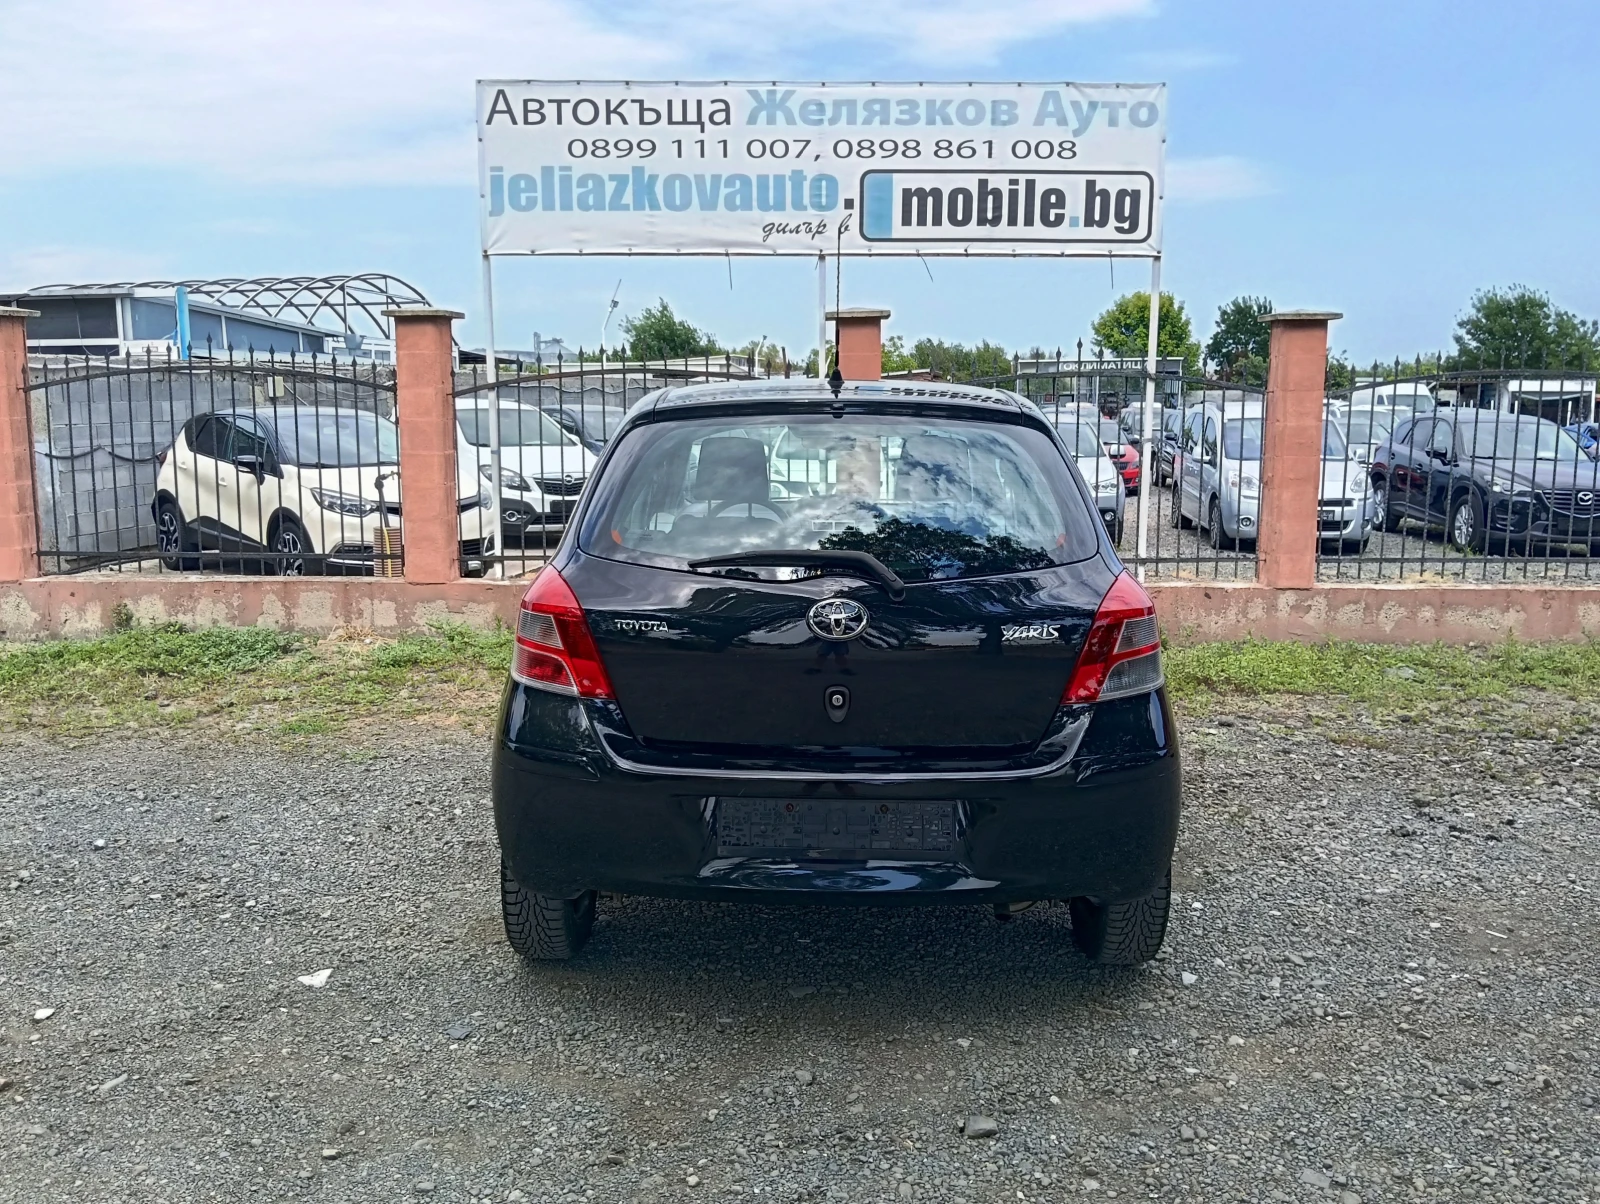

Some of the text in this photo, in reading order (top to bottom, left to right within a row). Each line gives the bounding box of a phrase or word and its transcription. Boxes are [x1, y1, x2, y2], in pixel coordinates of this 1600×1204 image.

[485, 88, 1160, 138] Автокъща Желязков Ауто
[567, 138, 1078, 162] 0899 111 007, 0898 861 008
[901, 177, 1142, 235] mobile.bg
[762, 219, 828, 243] дилър
[614, 619, 669, 633] TOYOTA
